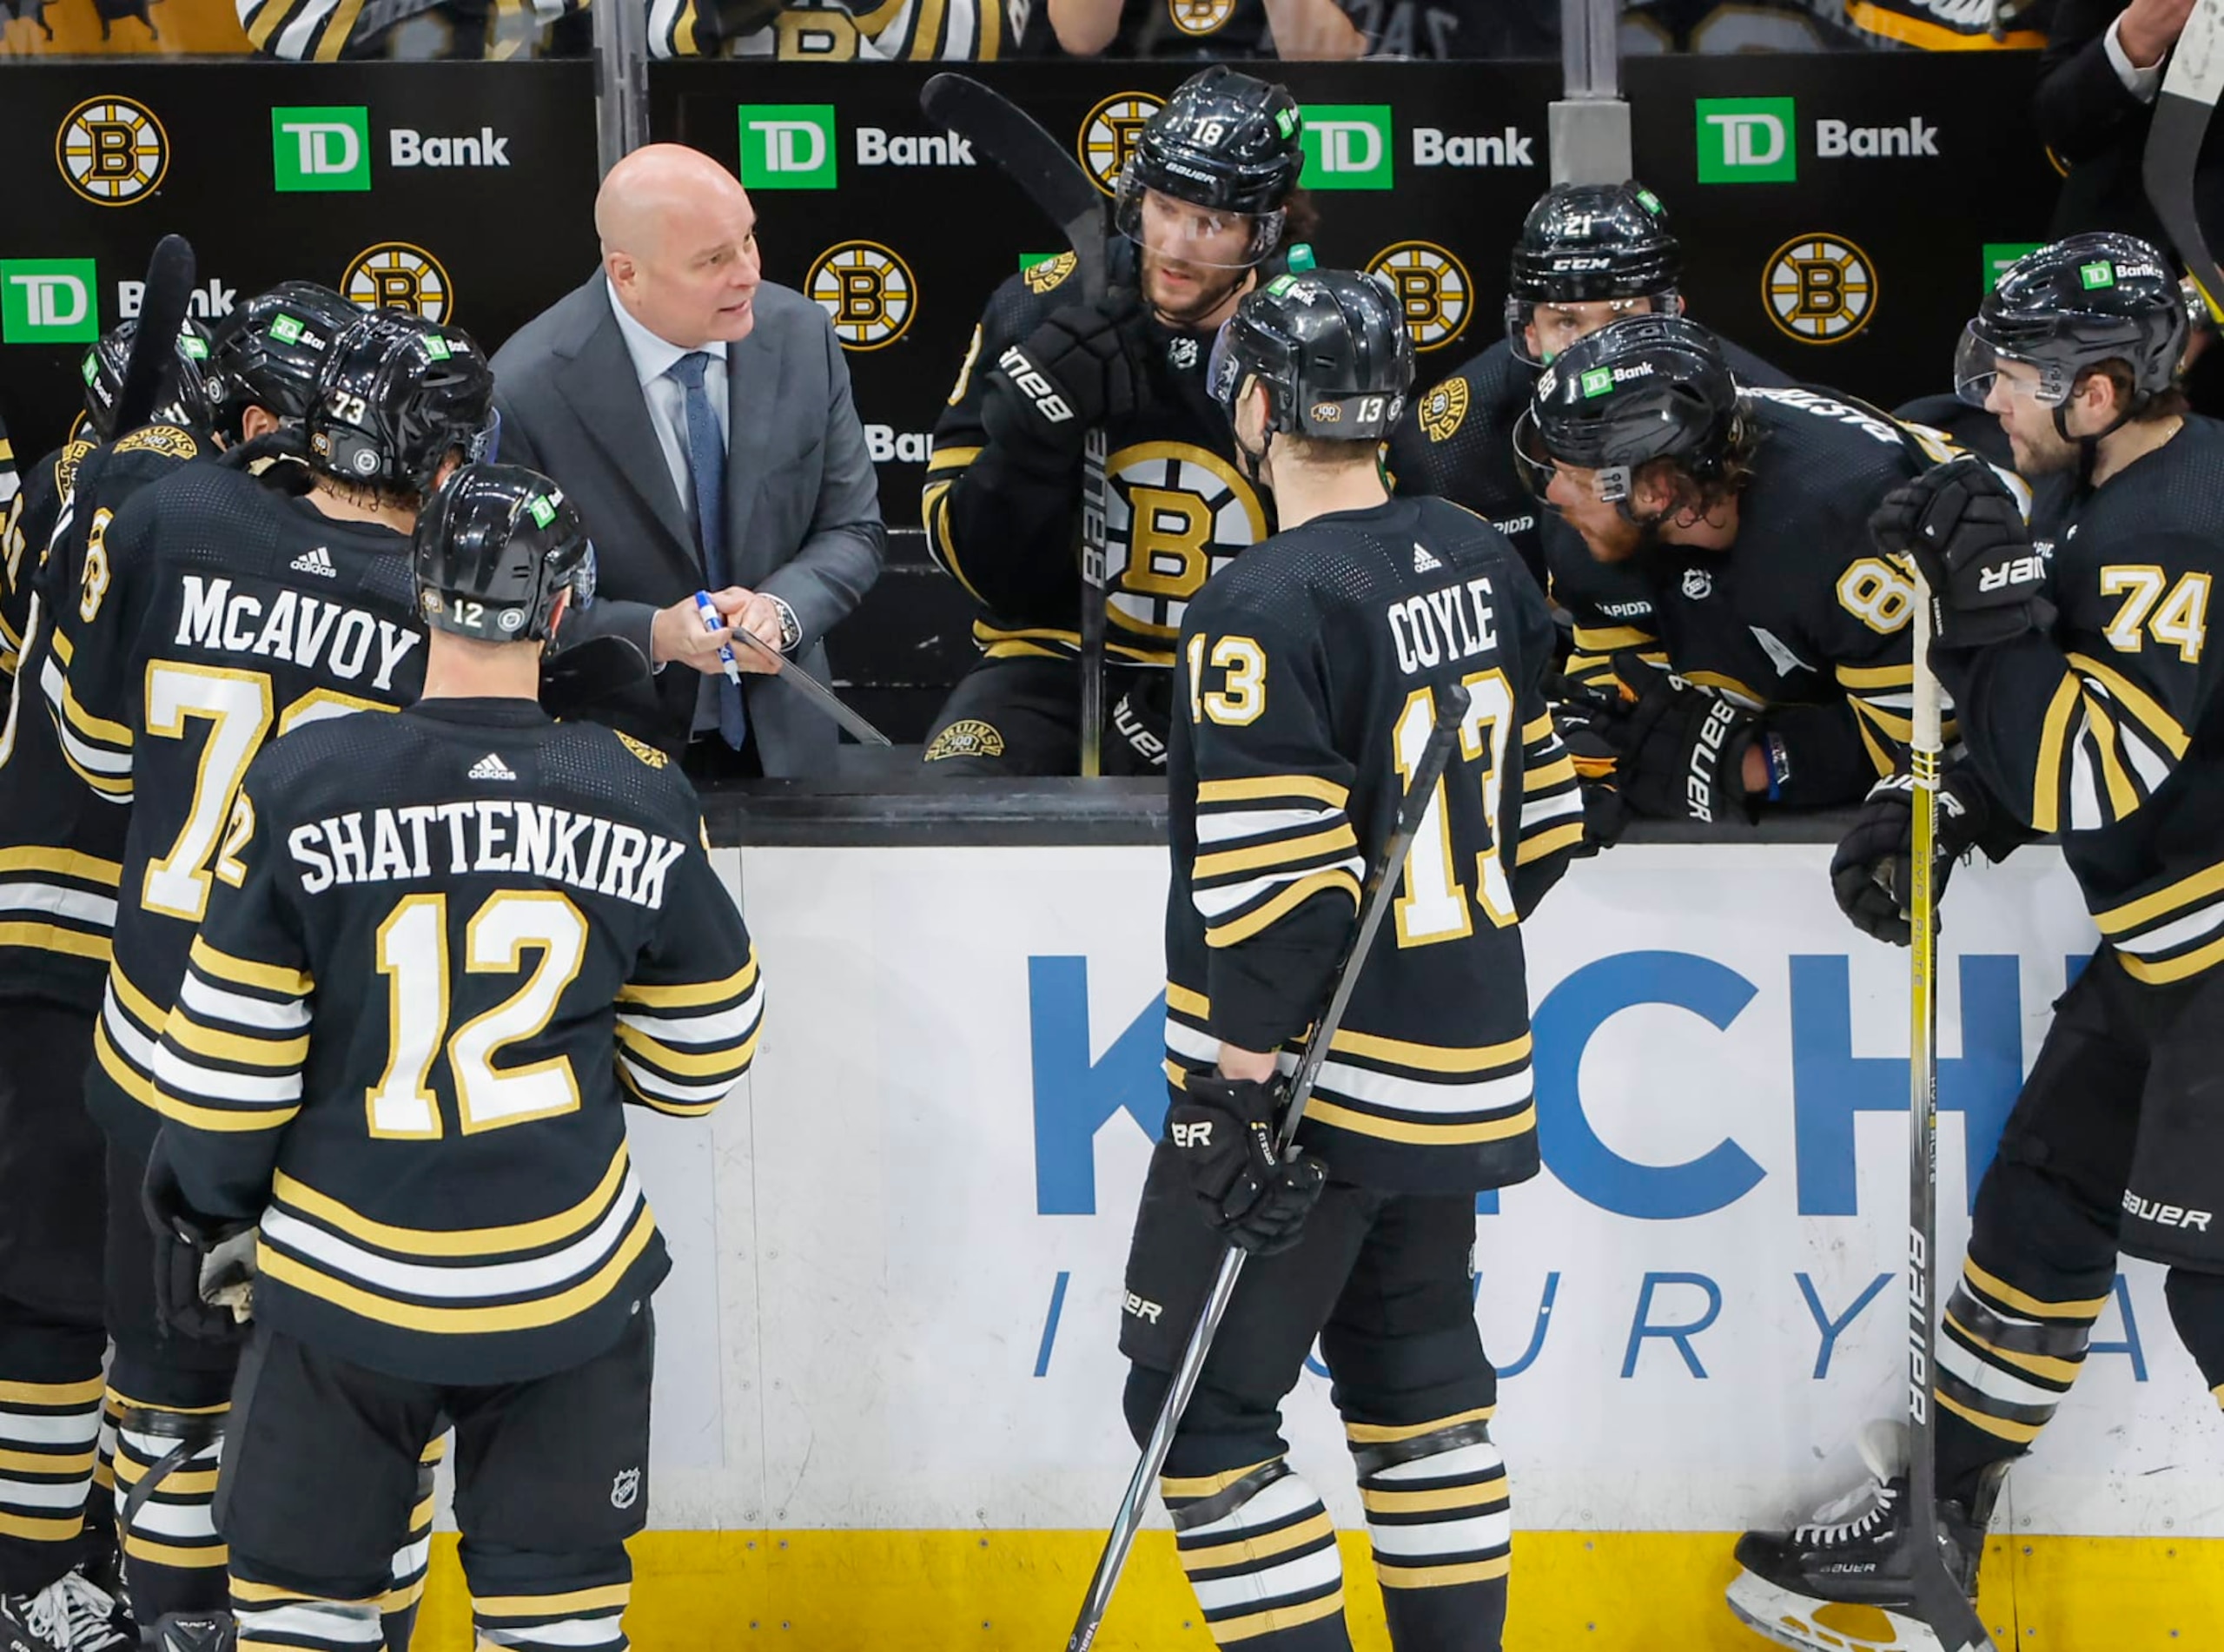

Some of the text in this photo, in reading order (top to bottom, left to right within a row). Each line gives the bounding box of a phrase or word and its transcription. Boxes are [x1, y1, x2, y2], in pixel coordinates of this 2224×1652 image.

[282, 123, 510, 174] TD Bank
[749, 121, 976, 172] TD Bank
[1191, 119, 1224, 146] 18
[1305, 121, 1533, 172] TD Bank
[1706, 114, 1939, 165] TD Bank
[1166, 162, 1216, 184] BAUER
[1564, 215, 1592, 235] 21
[1552, 258, 1611, 271] CCM
[2086, 263, 2151, 283] TD Bank
[10, 275, 237, 326] TD Bnk
[1537, 367, 1558, 402] 88
[1613, 361, 1654, 382] Bank
[334, 391, 366, 426] 73
[1356, 398, 1384, 423] 13
[1122, 487, 1214, 598] B
[290, 558, 337, 578] adidas
[452, 598, 484, 628] 12
[1387, 577, 1498, 676] COYLE
[2100, 565, 2213, 664] 74
[1187, 632, 1268, 727] 13
[951, 736, 971, 746] 100
[468, 770, 516, 781] adidas
[1687, 699, 1736, 823] BAUER
[288, 800, 686, 909] SHATTENKIRK
[365, 889, 589, 1140] 12
[2121, 1188, 2213, 1232] BAUER
